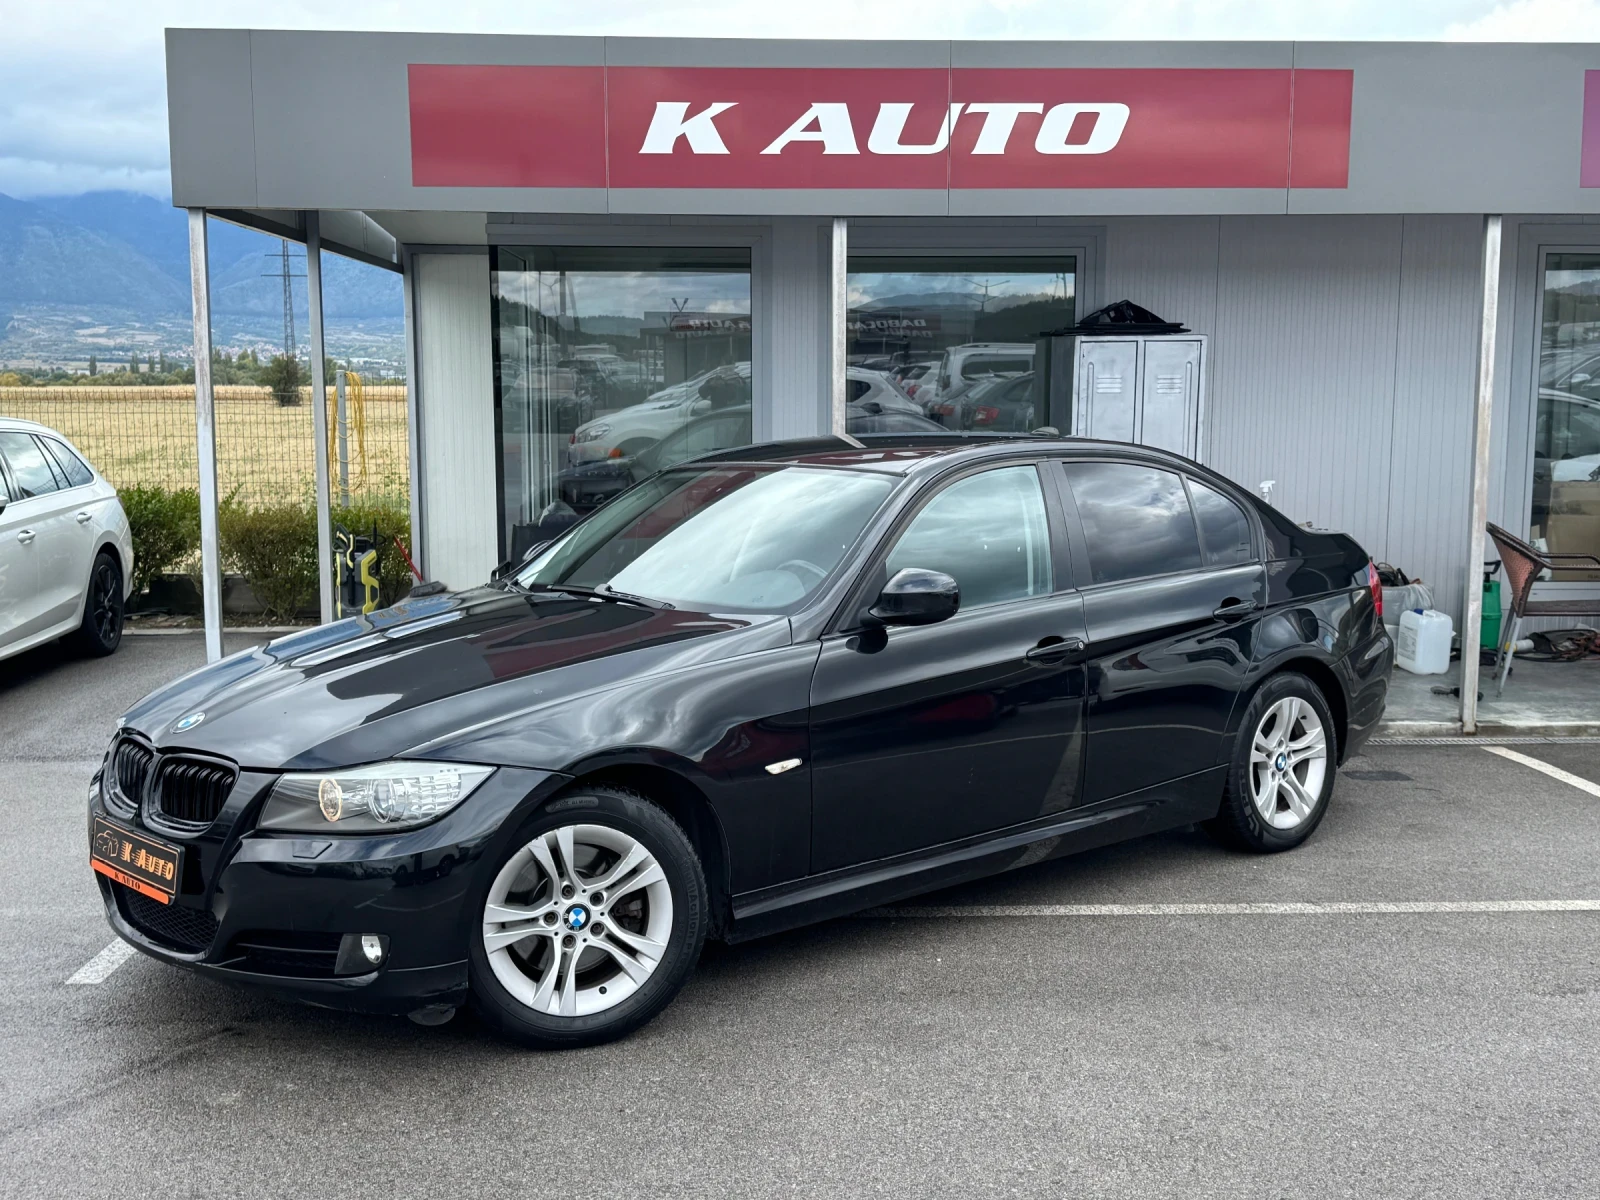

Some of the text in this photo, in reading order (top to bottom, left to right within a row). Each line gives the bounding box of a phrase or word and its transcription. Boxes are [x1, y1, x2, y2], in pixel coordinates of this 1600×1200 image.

[638, 102, 1131, 155] K AUTO
[114, 871, 141, 891] K AUTO
